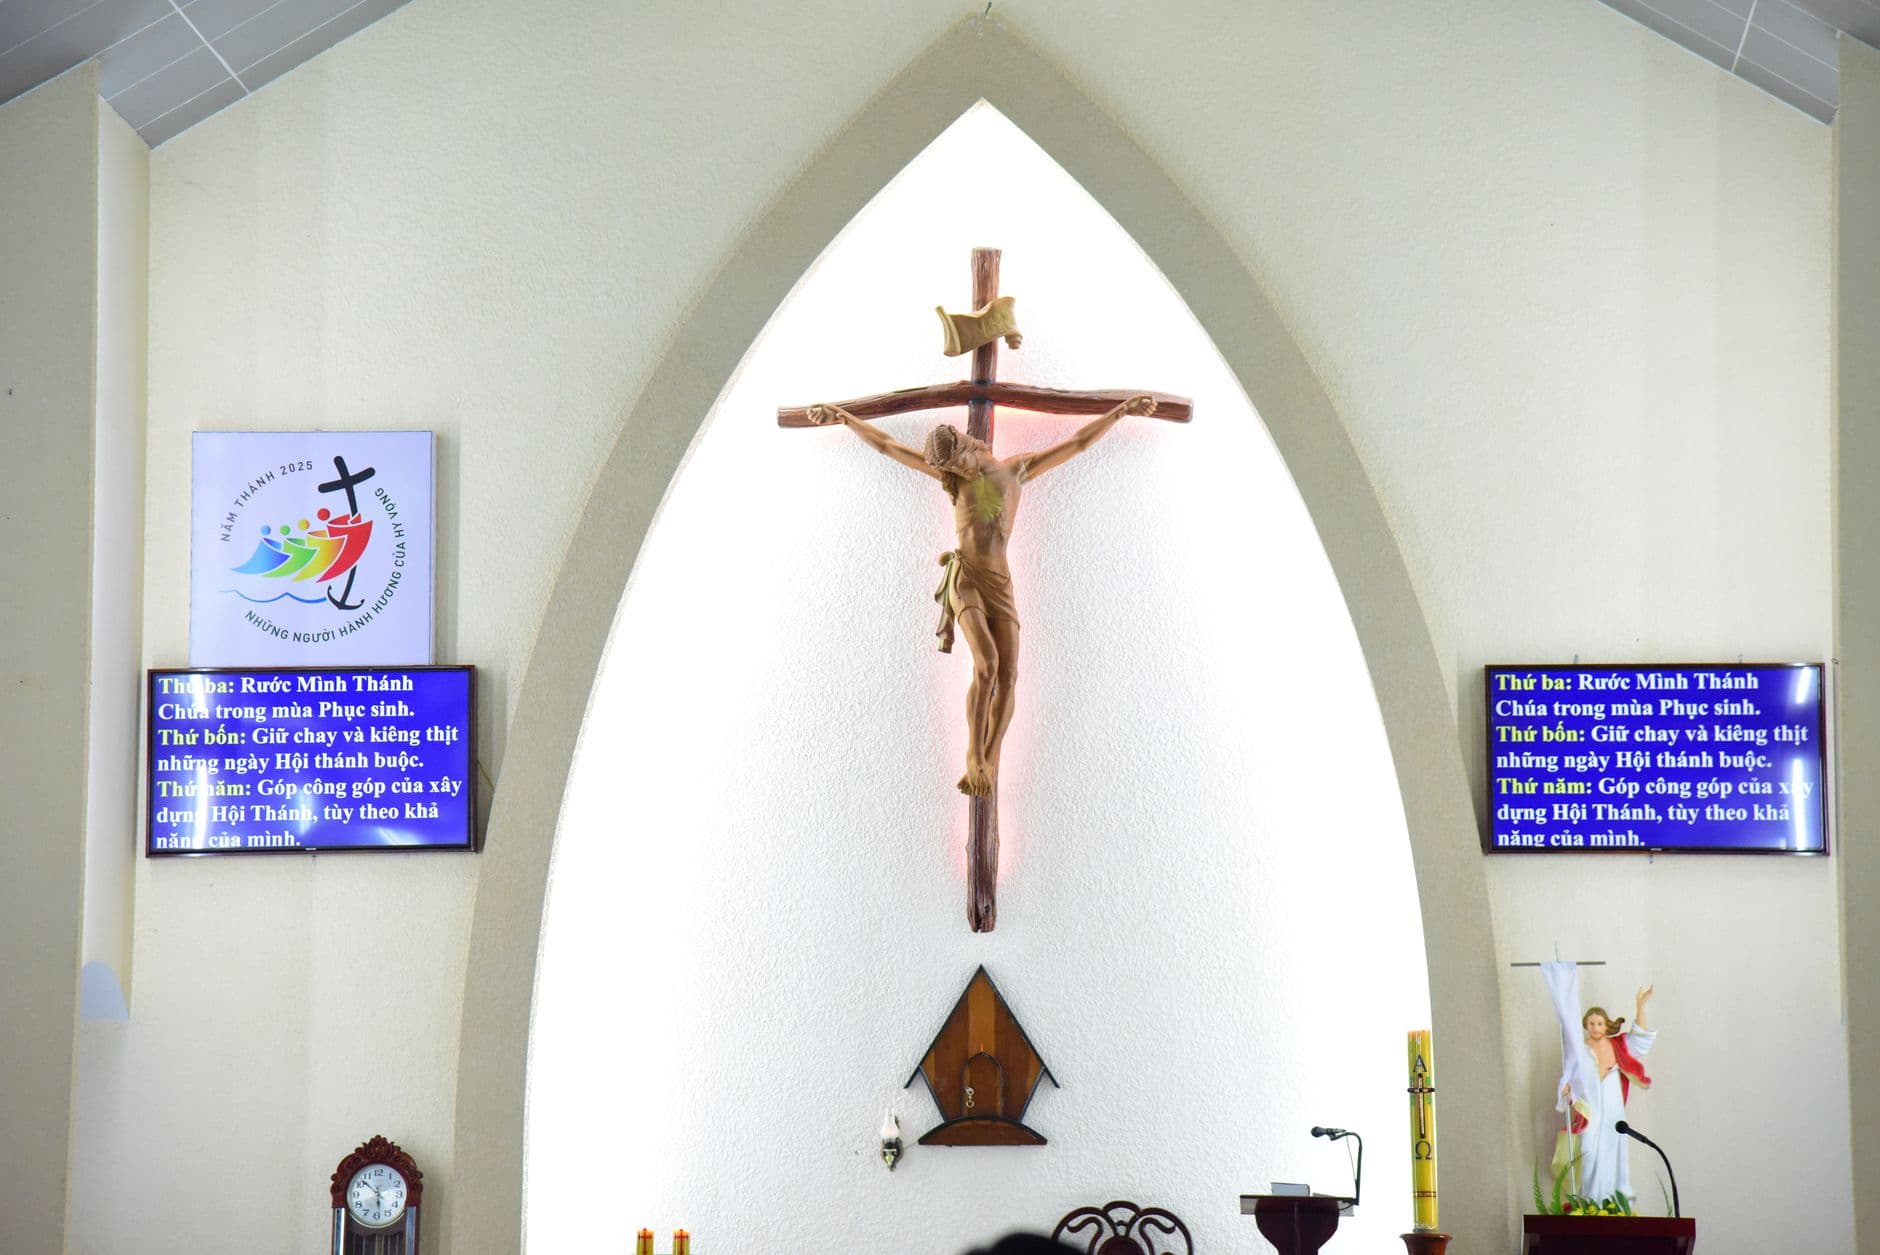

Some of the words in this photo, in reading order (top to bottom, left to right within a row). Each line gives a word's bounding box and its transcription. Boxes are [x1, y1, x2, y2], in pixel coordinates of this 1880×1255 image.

[233, 471, 275, 508] THÁNH
[279, 460, 313, 476] 2025
[392, 522, 405, 538] HY
[392, 541, 406, 567] CỦA
[372, 571, 402, 614] HƯƠNG
[245, 610, 289, 640] NHỮNG
[338, 612, 374, 638] HÀNH
[292, 628, 336, 643] NGƯỜI
[206, 677, 234, 693] ba:
[240, 676, 292, 693] Rước
[297, 675, 347, 692] Mình
[352, 674, 414, 692] Thánh
[1495, 673, 1537, 691] Thứ
[1541, 673, 1573, 690] ba:
[1577, 672, 1631, 690] Rước
[1636, 672, 1690, 690] Mình
[1693, 672, 1759, 690] Thánh
[215, 703, 267, 722] trong
[271, 702, 313, 718] mùa
[318, 701, 366, 722] Phục
[371, 700, 415, 717] sinh.
[1495, 698, 1548, 717] Chúa
[1553, 700, 1606, 720] trong
[1611, 698, 1654, 716] mùa
[1659, 699, 1709, 720] Phục
[1713, 698, 1761, 716] sinh.
[158, 728, 199, 746] Thứ
[204, 723, 246, 745] bốn:
[252, 727, 289, 744] Giữ
[293, 727, 338, 748] chay
[342, 726, 365, 743] và
[369, 725, 421, 746] kiêng
[426, 725, 459, 746] thịt
[1496, 725, 1538, 743] Thứ
[1542, 720, 1586, 743] bốn:
[1591, 725, 1631, 743] Giữ
[1634, 725, 1680, 746] chay
[1684, 725, 1709, 742] và
[1713, 724, 1768, 746] kiêng
[1773, 724, 1809, 746] thịt
[157, 754, 219, 775] những
[224, 754, 270, 774] ngày
[275, 752, 309, 773] Hội
[314, 752, 369, 769] thánh
[374, 751, 424, 772] buộc.
[1496, 751, 1559, 773] những
[1563, 751, 1611, 773] ngày
[1615, 750, 1651, 773] Hội
[1656, 751, 1713, 768] thánh
[1719, 750, 1773, 772] buộc.
[157, 780, 199, 797] Thứ
[257, 779, 298, 800] Góp
[302, 778, 348, 798] công
[351, 777, 386, 798] góp
[391, 777, 424, 794] của
[429, 776, 463, 797] xây
[1496, 777, 1539, 795] Thứ
[1543, 777, 1592, 794] năm:
[1598, 777, 1641, 799] Góp
[1645, 777, 1692, 799] công
[1696, 777, 1733, 799] góp
[1738, 777, 1773, 795] của
[1778, 777, 1814, 800] xy
[156, 807, 206, 827] dựn
[211, 805, 246, 826] Hội
[250, 804, 318, 823] Thánh,
[323, 803, 354, 824] tùy
[359, 803, 399, 820] theo
[404, 802, 439, 819] khả
[1496, 803, 1548, 825] dựng
[1552, 803, 1588, 825] Hội
[1591, 803, 1663, 824] Thánh,
[1668, 803, 1700, 825] tùy
[1704, 803, 1748, 821] theo
[1752, 803, 1790, 821] khả
[156, 832, 203, 849] năn
[208, 831, 241, 848] của
[247, 830, 301, 847] mình.
[1497, 829, 1546, 847] năng
[1550, 829, 1585, 847] của
[1590, 829, 1646, 847] mình.
[1415, 1140, 1432, 1160] Ω
[363, 1172, 372, 1180] 11
[374, 1168, 384, 1177] 12
[388, 1172, 393, 1180] 1
[356, 1180, 365, 1189] 10
[393, 1180, 401, 1188] 2
[352, 1191, 361, 1199] 9
[354, 1200, 363, 1208] 8
[395, 1190, 403, 1199] 3
[362, 1209, 370, 1217] 7
[384, 1209, 392, 1217] 5
[391, 1200, 399, 1209] 4
[373, 1211, 381, 1220] 6
